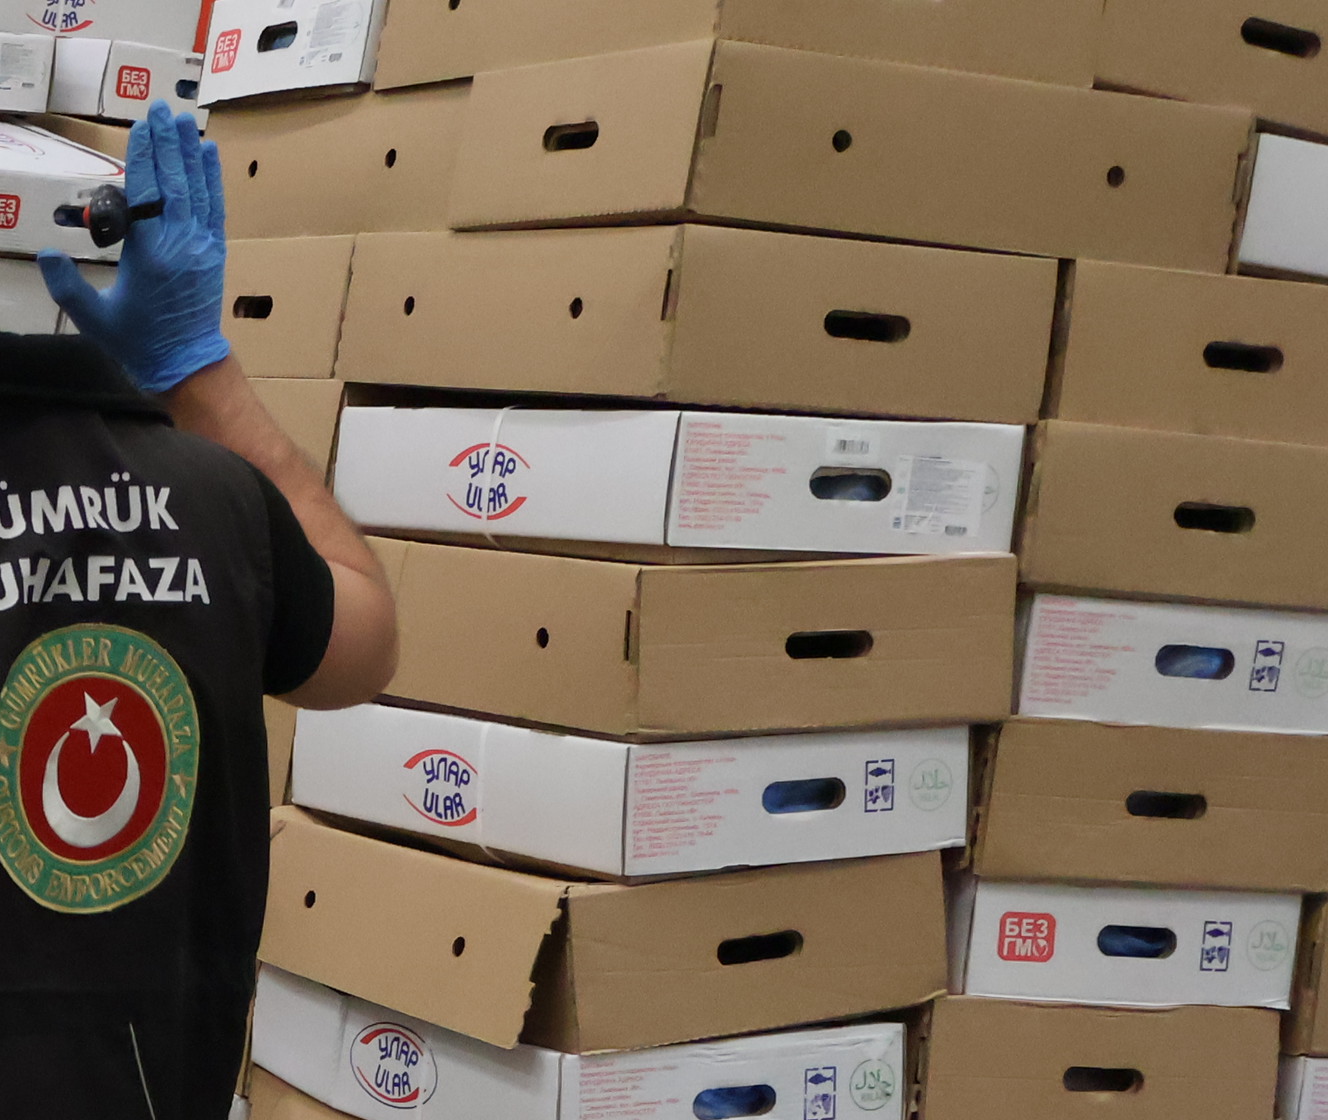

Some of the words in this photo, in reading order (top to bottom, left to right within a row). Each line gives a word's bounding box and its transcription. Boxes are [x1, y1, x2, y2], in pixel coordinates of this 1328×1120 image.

[122, 69, 147, 85] БЕЗ
[466, 482, 509, 513] ULAR
[422, 757, 470, 788] УЛАР
[422, 787, 466, 820] ULAR
[45, 805, 184, 901] ENFORCEMENT
[1005, 917, 1049, 938] БЕЗ
[1003, 937, 1049, 957] ГМО
[378, 1035, 419, 1068] УЛАР
[374, 1064, 412, 1097] ULAR
